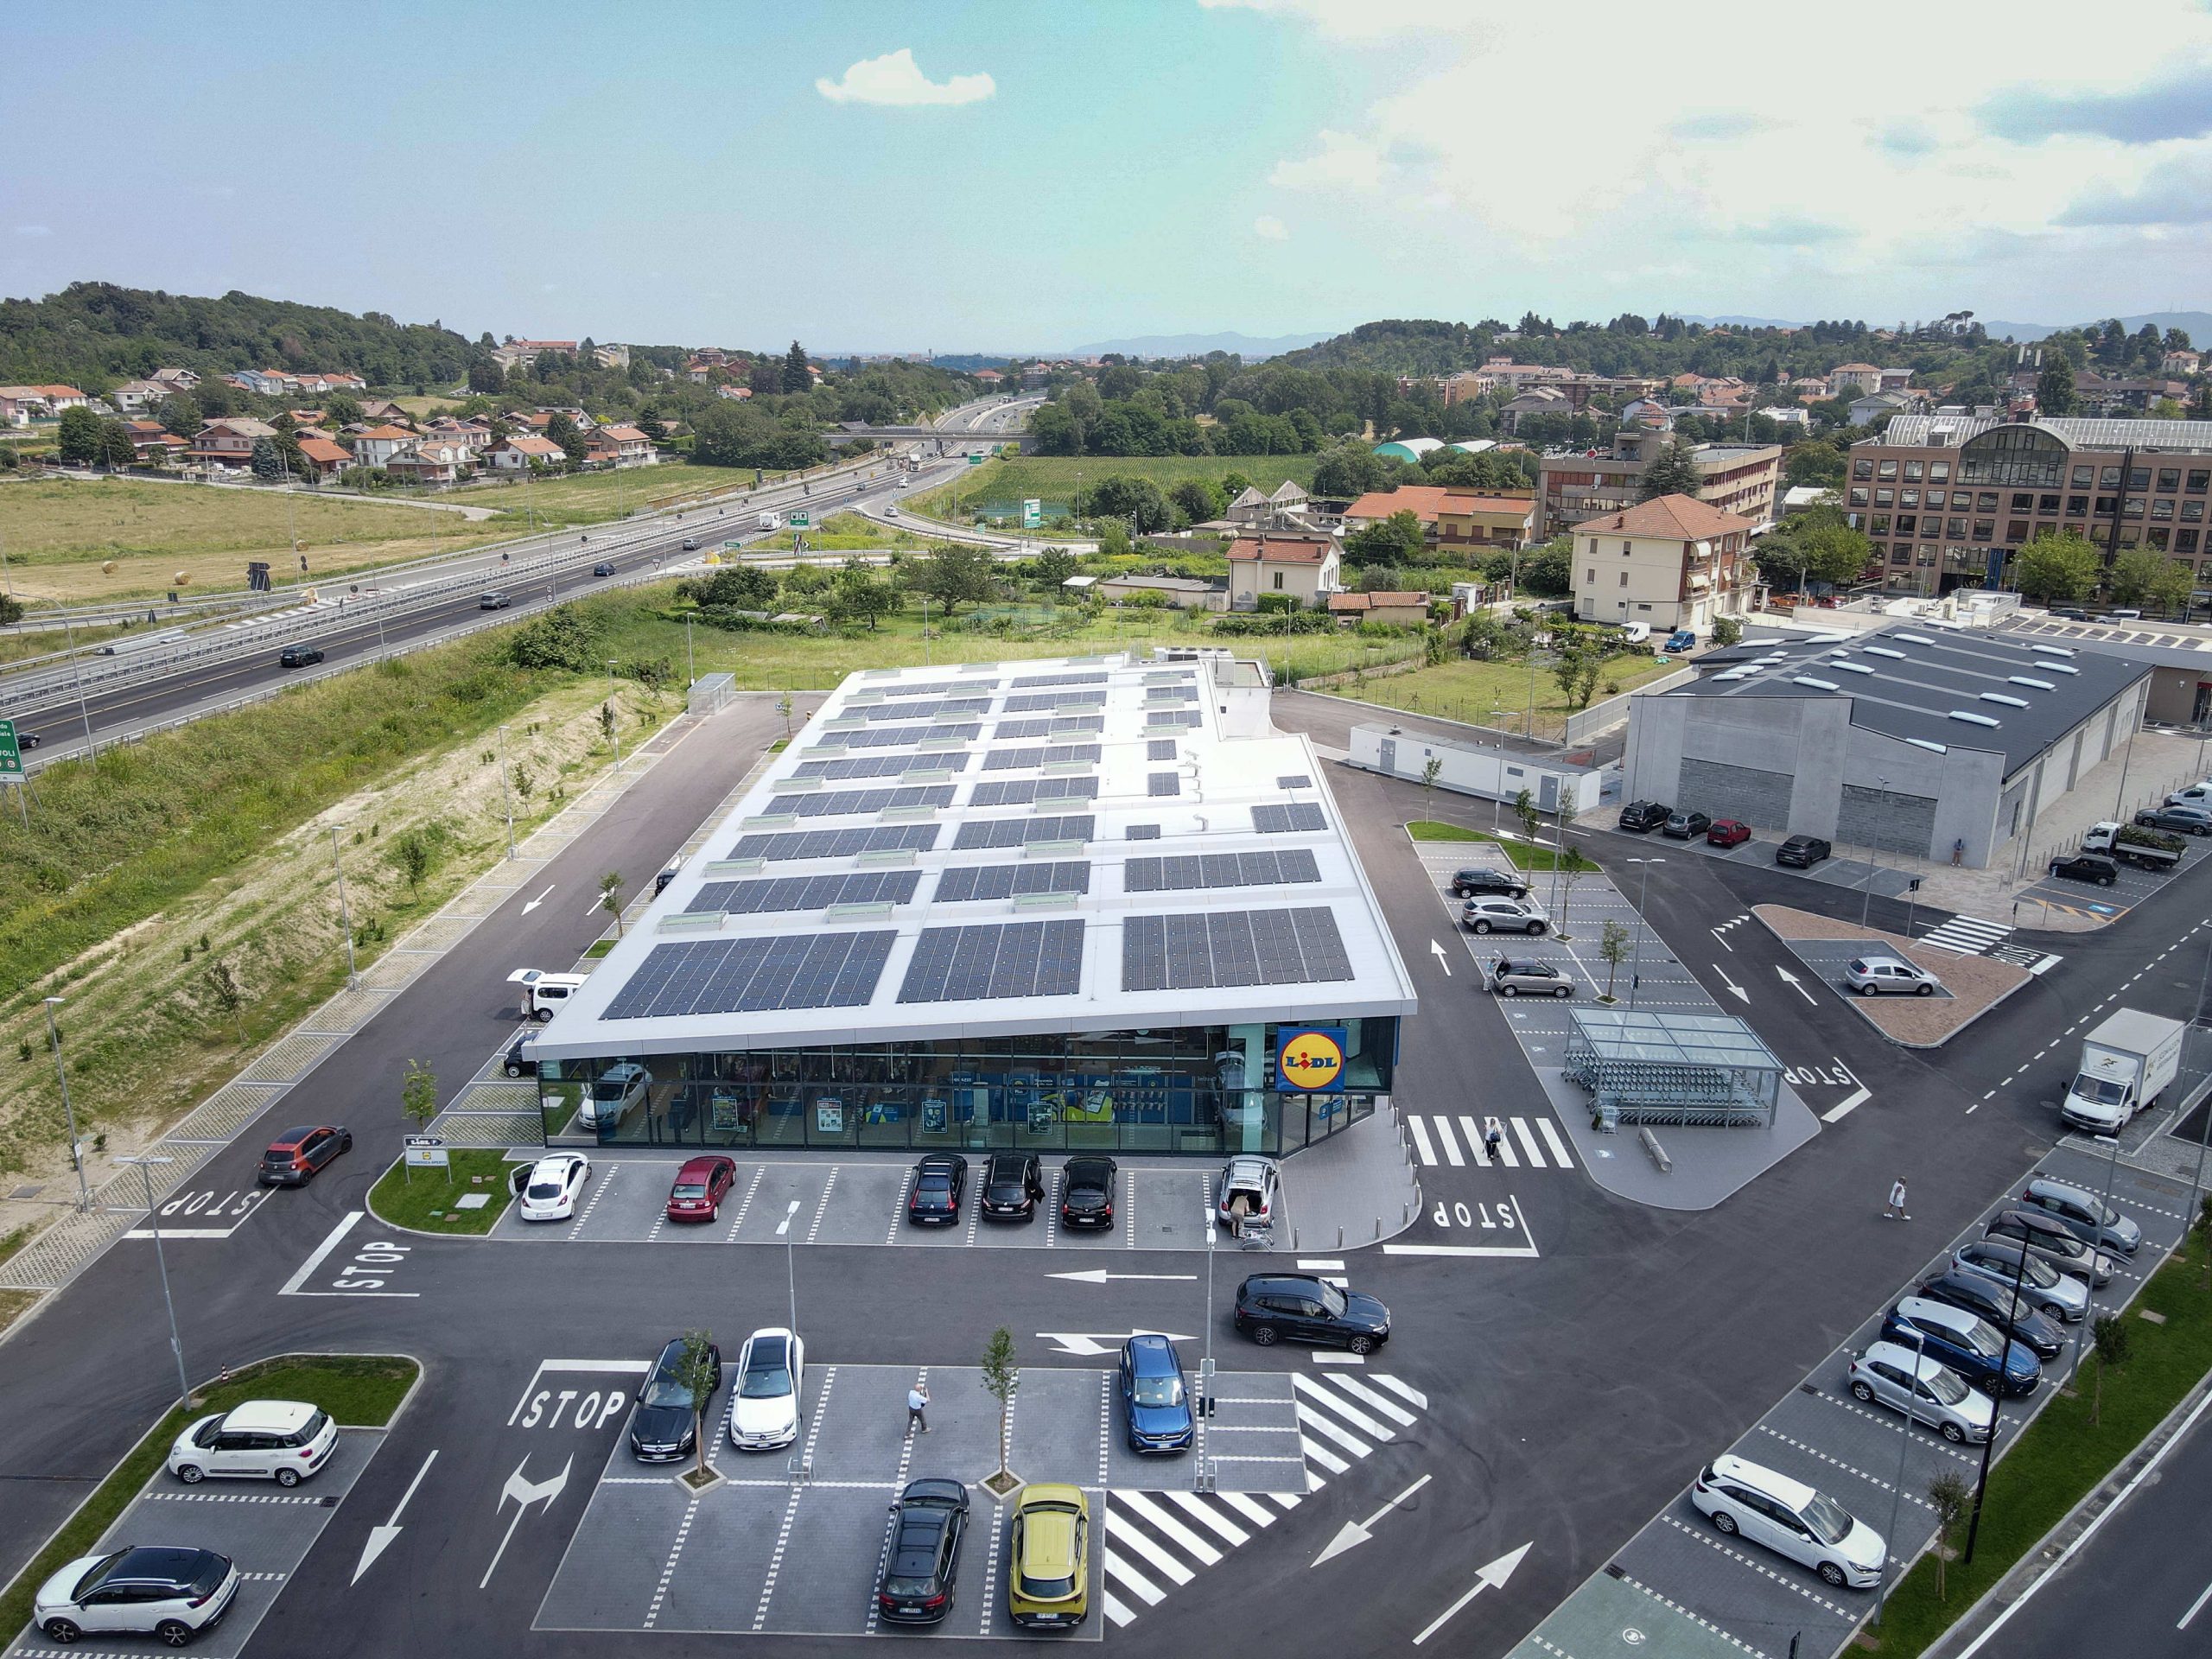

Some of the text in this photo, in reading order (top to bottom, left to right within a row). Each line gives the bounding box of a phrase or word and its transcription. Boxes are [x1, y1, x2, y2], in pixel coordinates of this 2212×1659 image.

[1988, 946, 2040, 966] STOP
[1783, 1066, 1852, 1085] STOP
[160, 1191, 261, 1216] STOP
[1433, 1201, 1515, 1229] STOP
[332, 1242, 412, 1290] STOP
[521, 1390, 626, 1429] STOP
